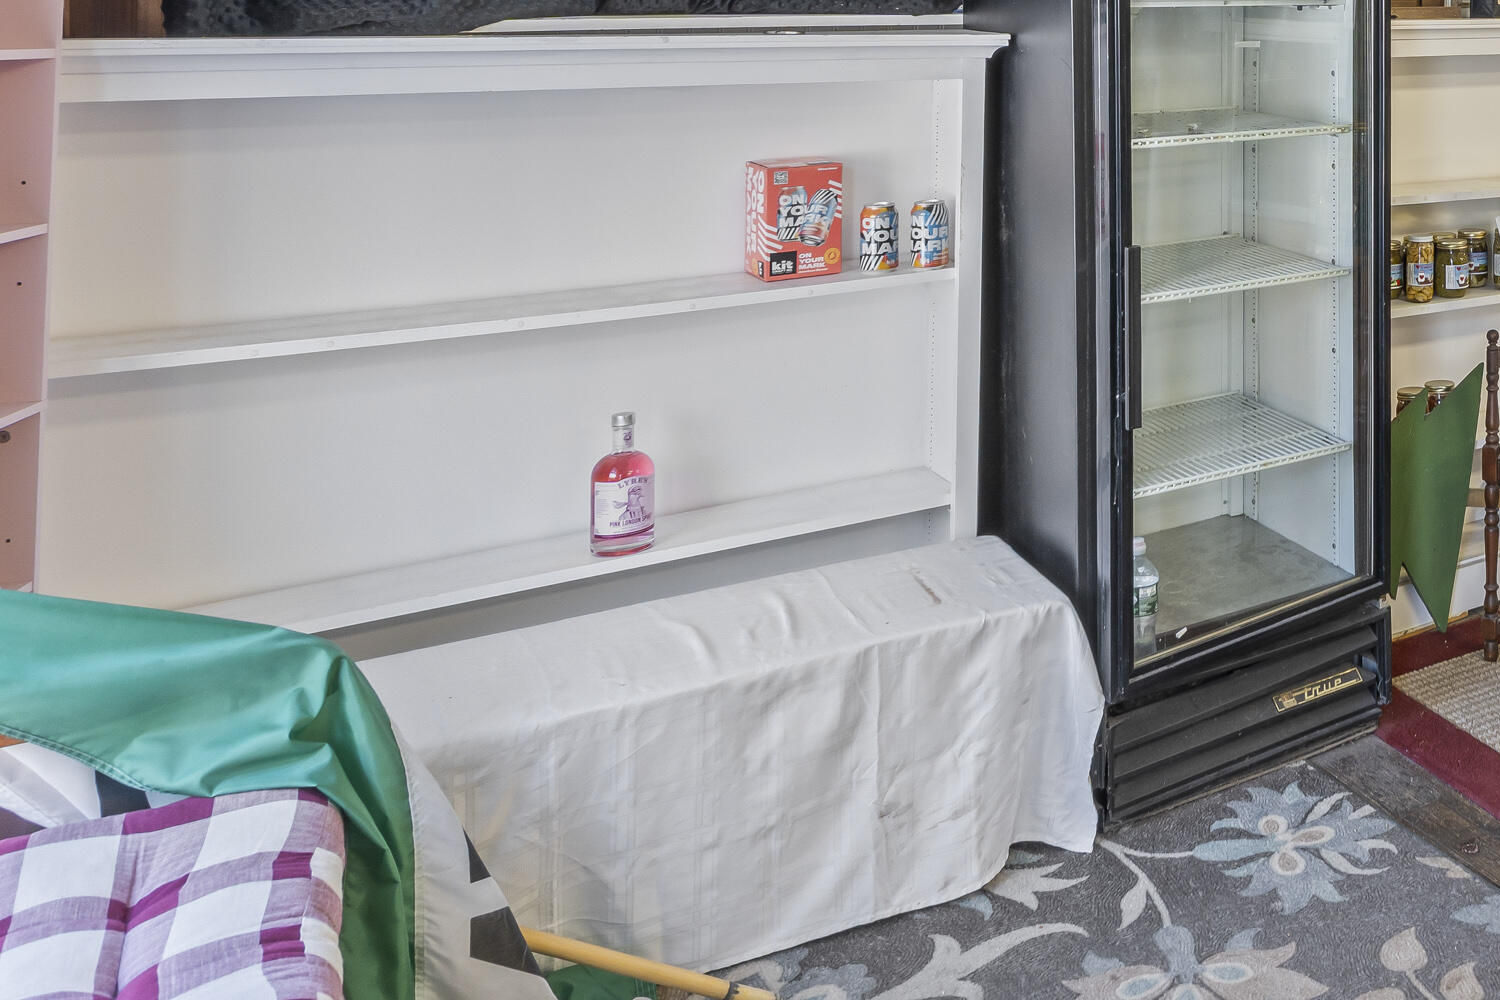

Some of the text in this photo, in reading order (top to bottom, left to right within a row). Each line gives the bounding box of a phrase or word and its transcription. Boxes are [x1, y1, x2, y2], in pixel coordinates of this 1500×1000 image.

[779, 194, 807, 206] ON
[862, 215, 890, 230] ON
[862, 228, 898, 242] YOU
[771, 260, 794, 271] kit
[799, 262, 825, 270] MARK
